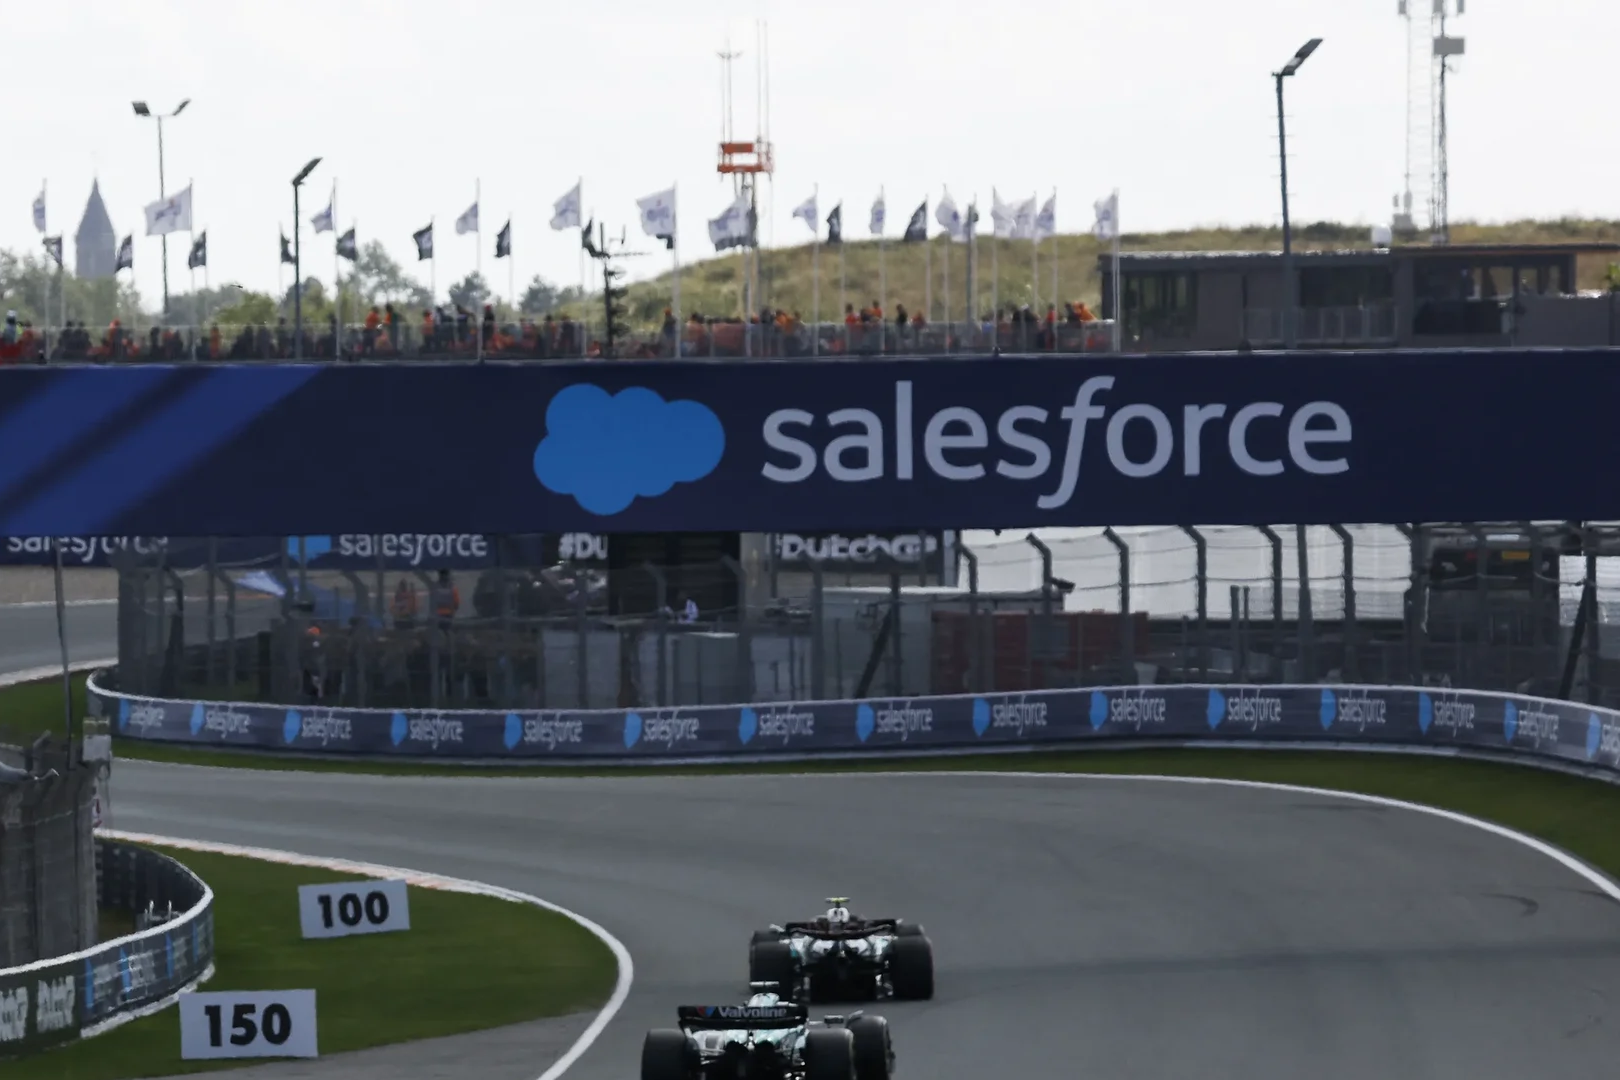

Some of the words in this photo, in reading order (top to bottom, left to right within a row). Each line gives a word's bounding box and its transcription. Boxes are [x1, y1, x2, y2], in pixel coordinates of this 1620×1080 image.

[761, 375, 1354, 511] salesforce
[643, 709, 699, 748] salesforce
[758, 704, 814, 745] salesforce
[876, 701, 932, 741] salesforce
[992, 695, 1047, 736] salesforce
[1110, 690, 1166, 731] salesforce
[1227, 689, 1282, 731] salesforce
[1338, 689, 1387, 732] salesforce
[317, 890, 390, 929] 100
[204, 1003, 292, 1047] 150
[717, 1005, 787, 1019] Valvoline
